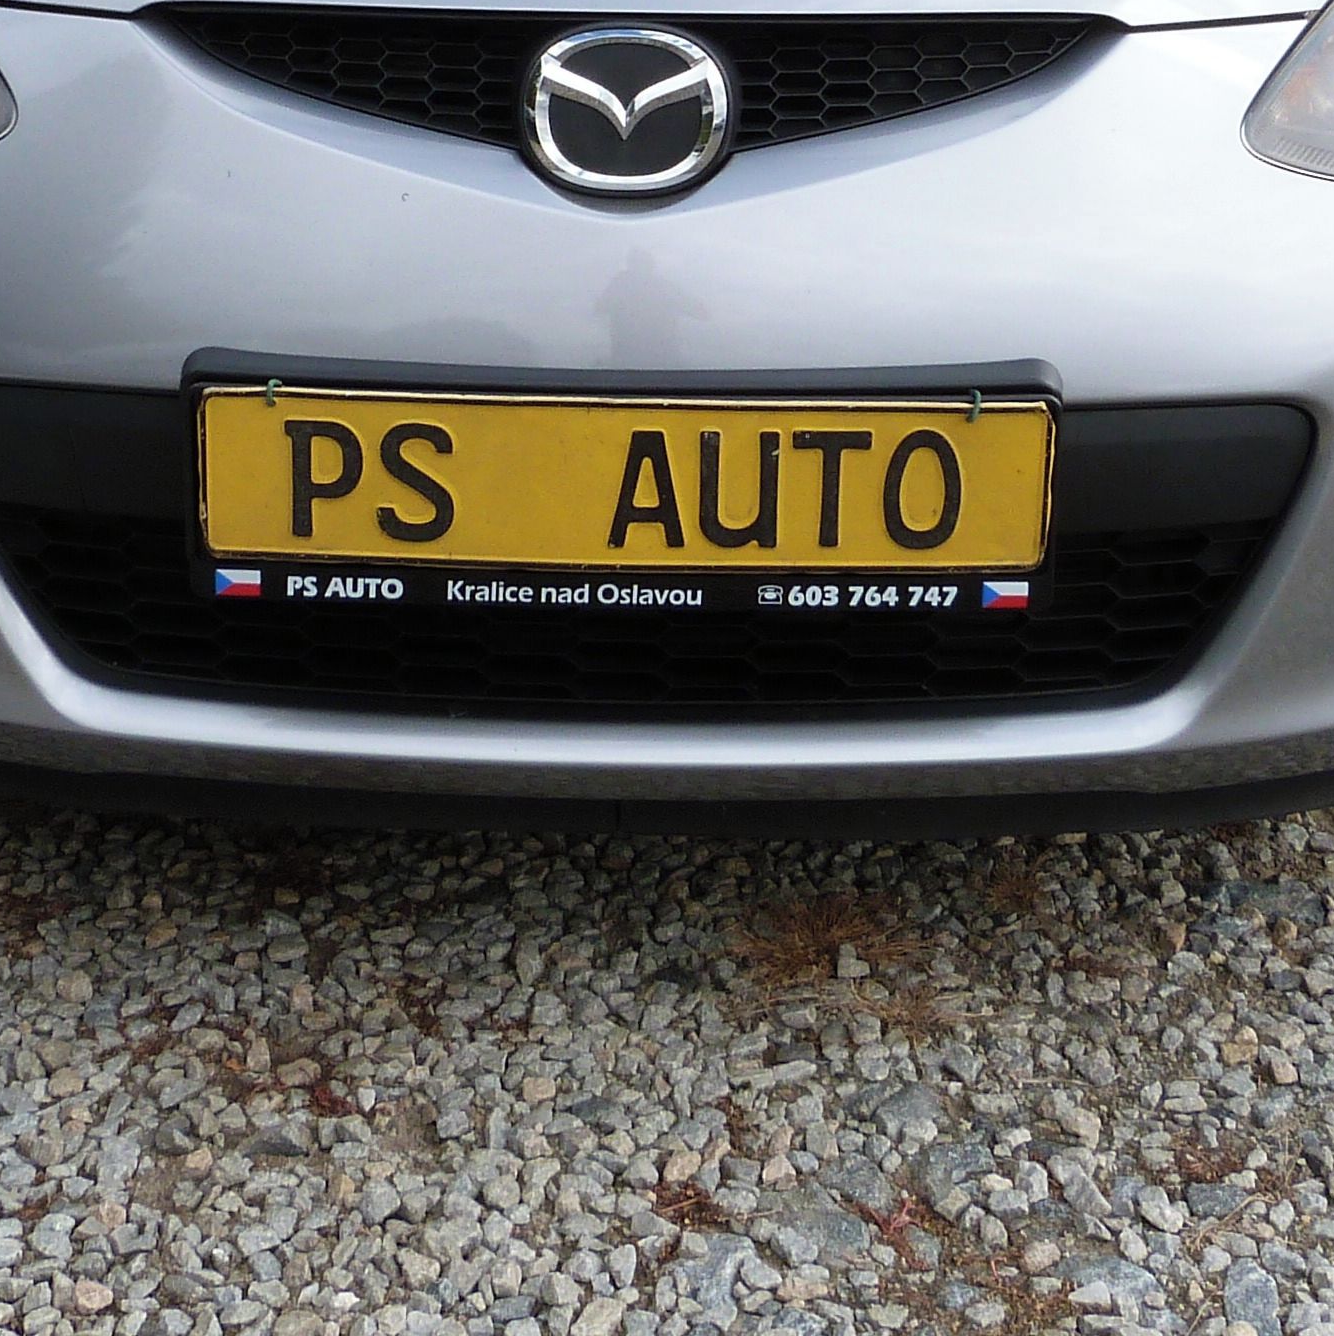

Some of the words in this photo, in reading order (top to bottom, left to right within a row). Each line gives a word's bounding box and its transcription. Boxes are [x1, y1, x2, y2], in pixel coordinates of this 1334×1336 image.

[283, 419, 455, 542] PS
[607, 428, 962, 550] AUTO
[286, 575, 318, 597] PS
[324, 576, 404, 599] AUTO
[447, 580, 534, 603] Kralice
[540, 583, 590, 604] nad
[597, 583, 703, 606] Oslavou
[787, 585, 839, 607] 603
[848, 585, 899, 607] 764
[908, 586, 958, 607] 747
